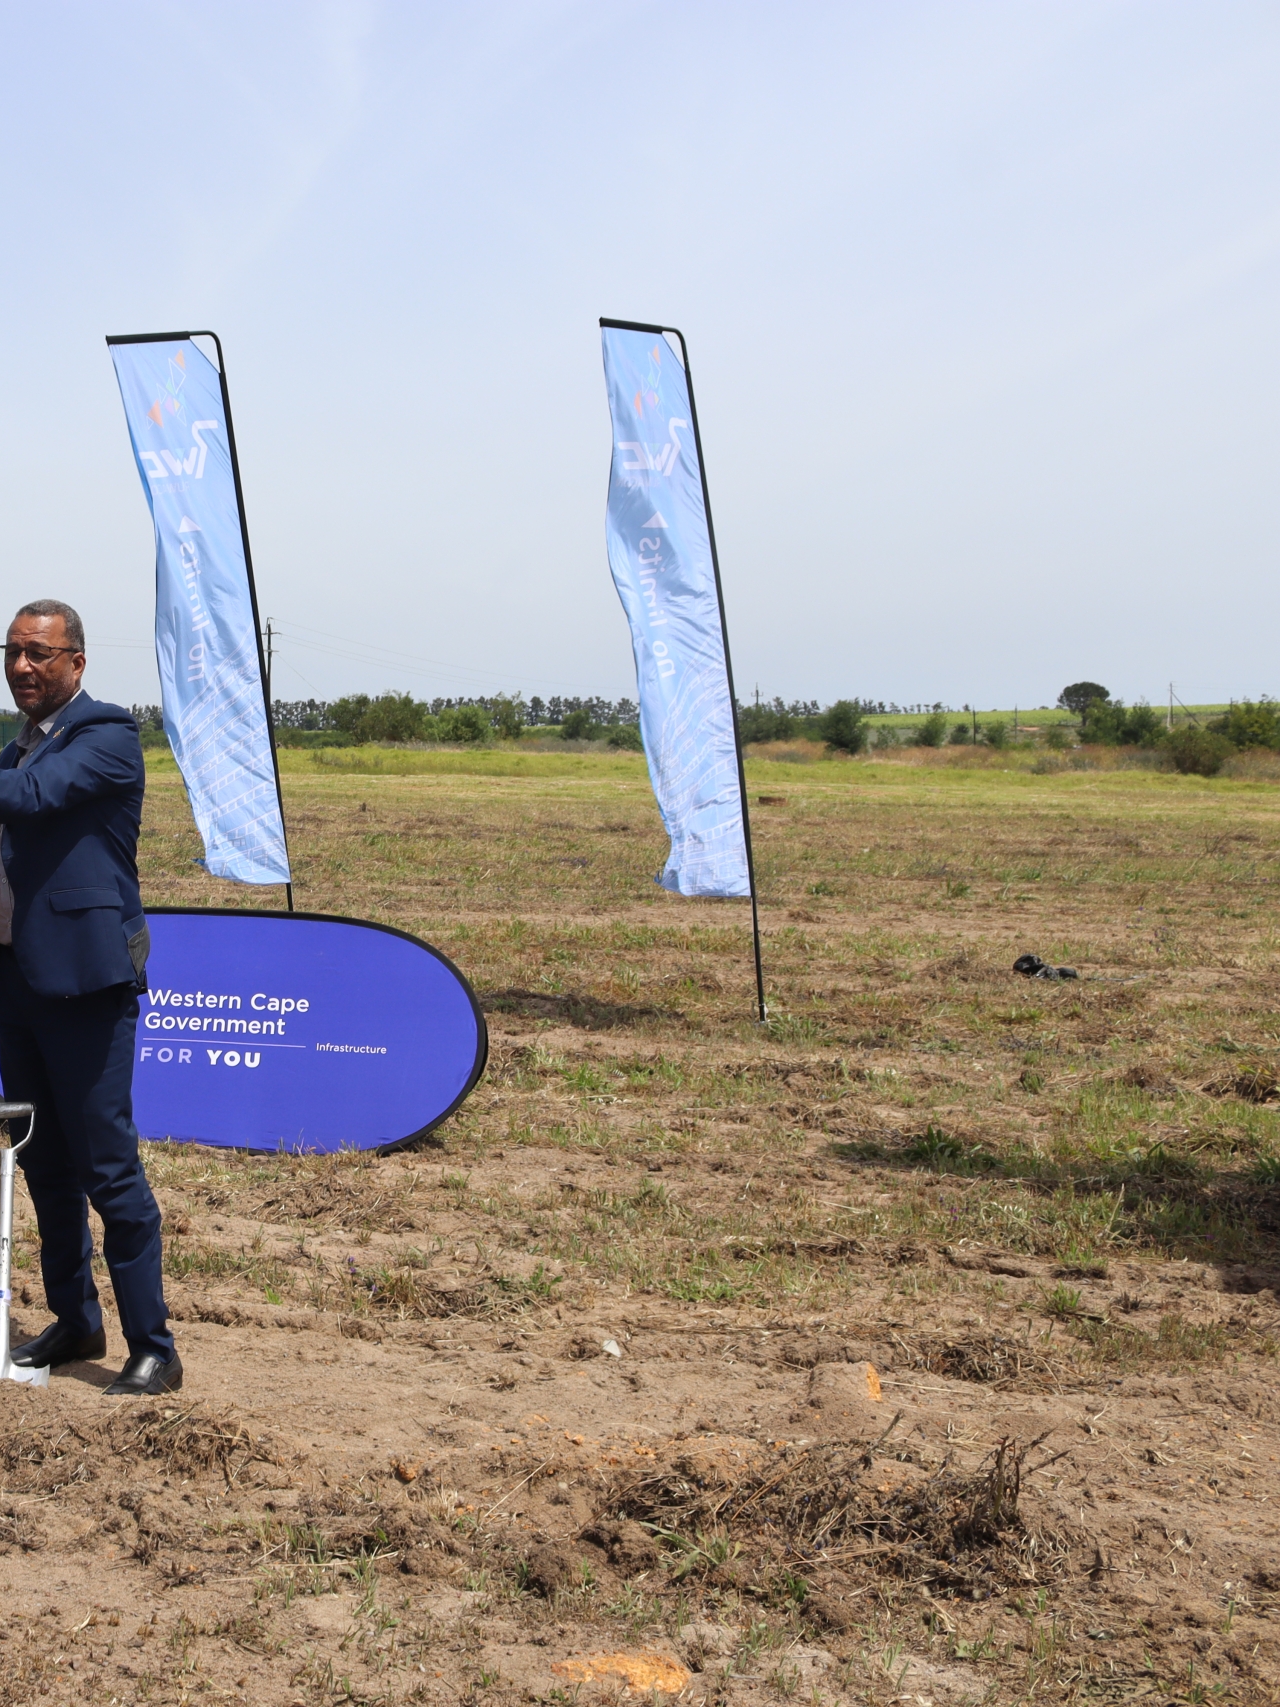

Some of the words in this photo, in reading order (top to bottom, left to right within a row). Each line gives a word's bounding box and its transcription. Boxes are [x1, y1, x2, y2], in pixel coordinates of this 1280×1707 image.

[147, 989, 241, 1009] Western
[250, 993, 310, 1014] Cape
[144, 1012, 286, 1035] Government
[140, 1047, 192, 1063] FOR
[207, 1049, 261, 1068] YOU
[316, 1043, 387, 1054] Infrastructure
